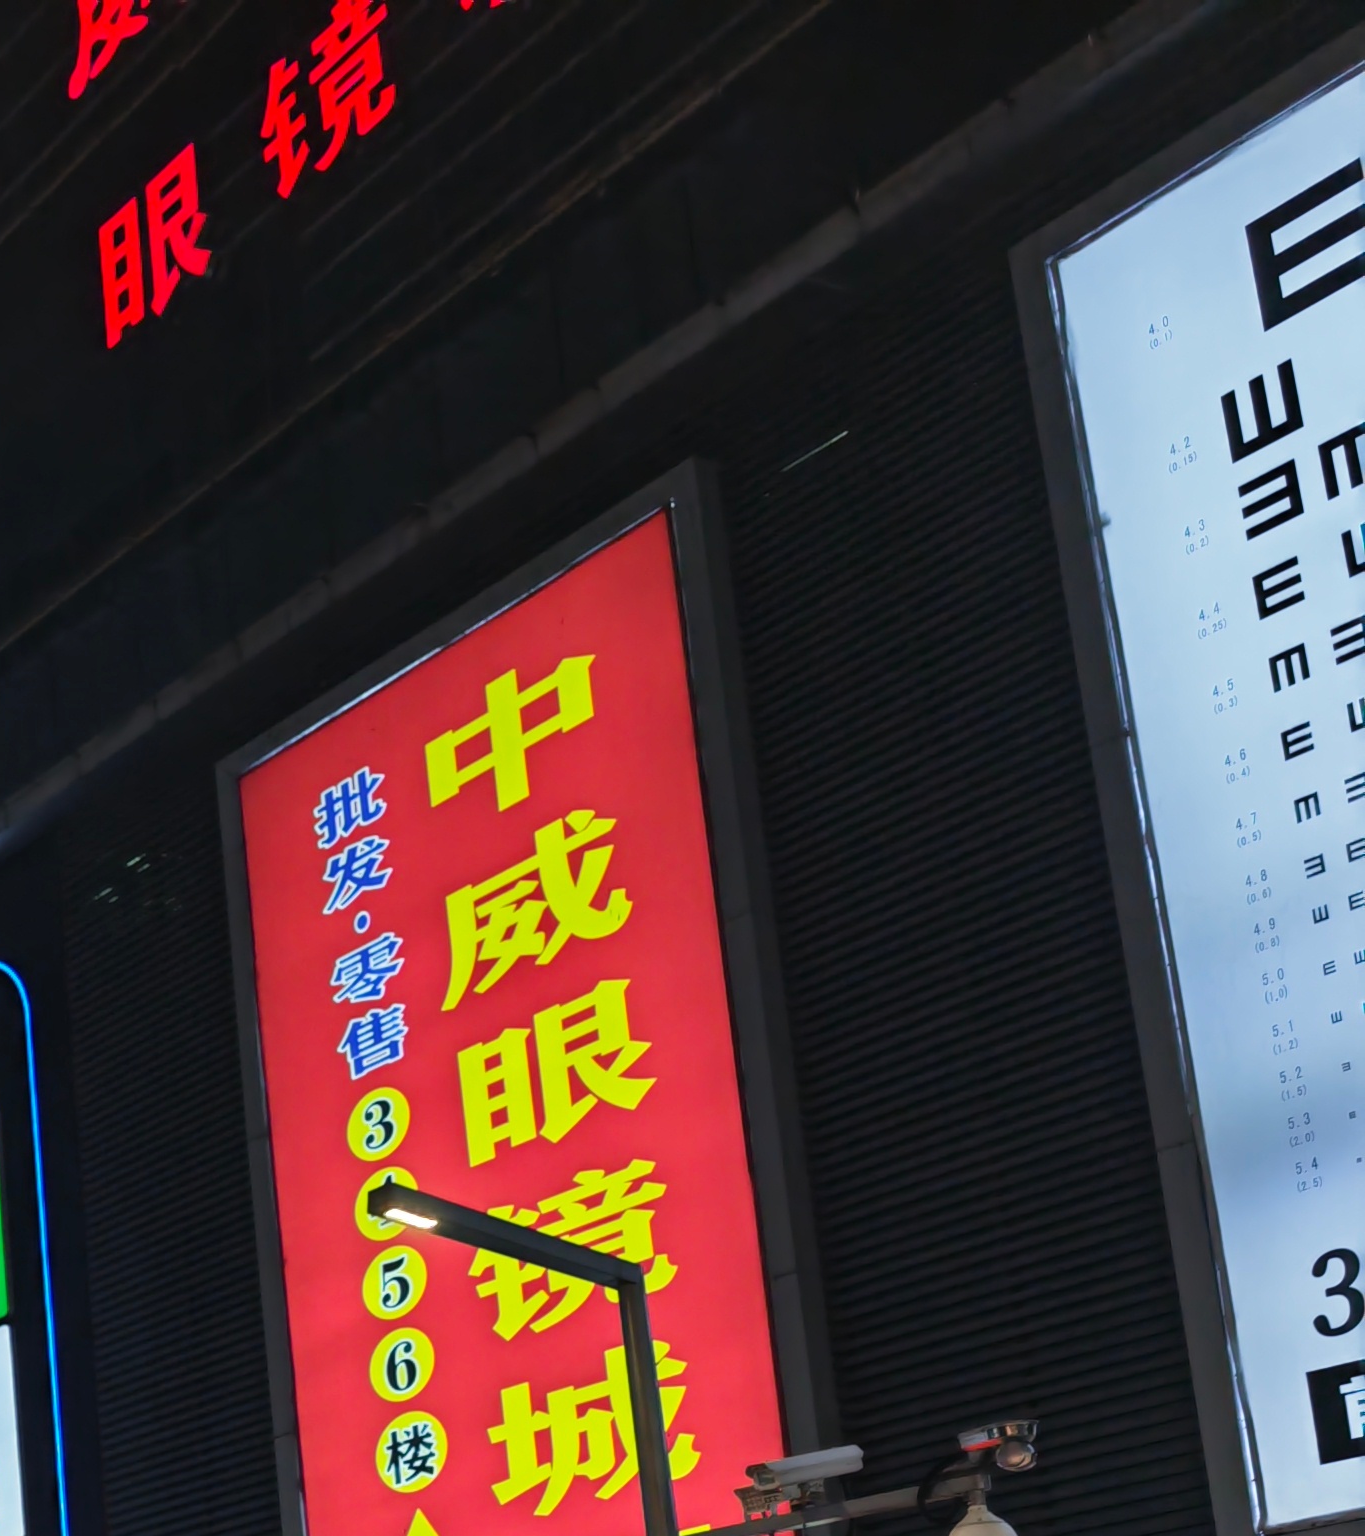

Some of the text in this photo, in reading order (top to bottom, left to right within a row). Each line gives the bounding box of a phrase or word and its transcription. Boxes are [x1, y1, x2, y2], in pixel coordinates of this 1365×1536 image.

[98, 0, 507, 349] 眼镜
[1148, 315, 1169, 335] 4.0
[1169, 435, 1191, 456] 4.2
[1184, 518, 1206, 538] 4.3
[1198, 601, 1221, 622] 4.4
[1212, 678, 1234, 697] 4.5
[1224, 748, 1247, 767] 4.6
[1235, 811, 1258, 831] 4.7
[1245, 869, 1268, 888] 4.8
[1253, 917, 1276, 936] 4.9
[1261, 967, 1285, 986] 5.0
[1272, 1019, 1294, 1038] 5.1
[1279, 1065, 1303, 1085] 5.2
[424, 653, 702, 1518] 中威眼镜城
[1287, 1112, 1311, 1131] 5.3
[1295, 1156, 1319, 1176] 5.4
